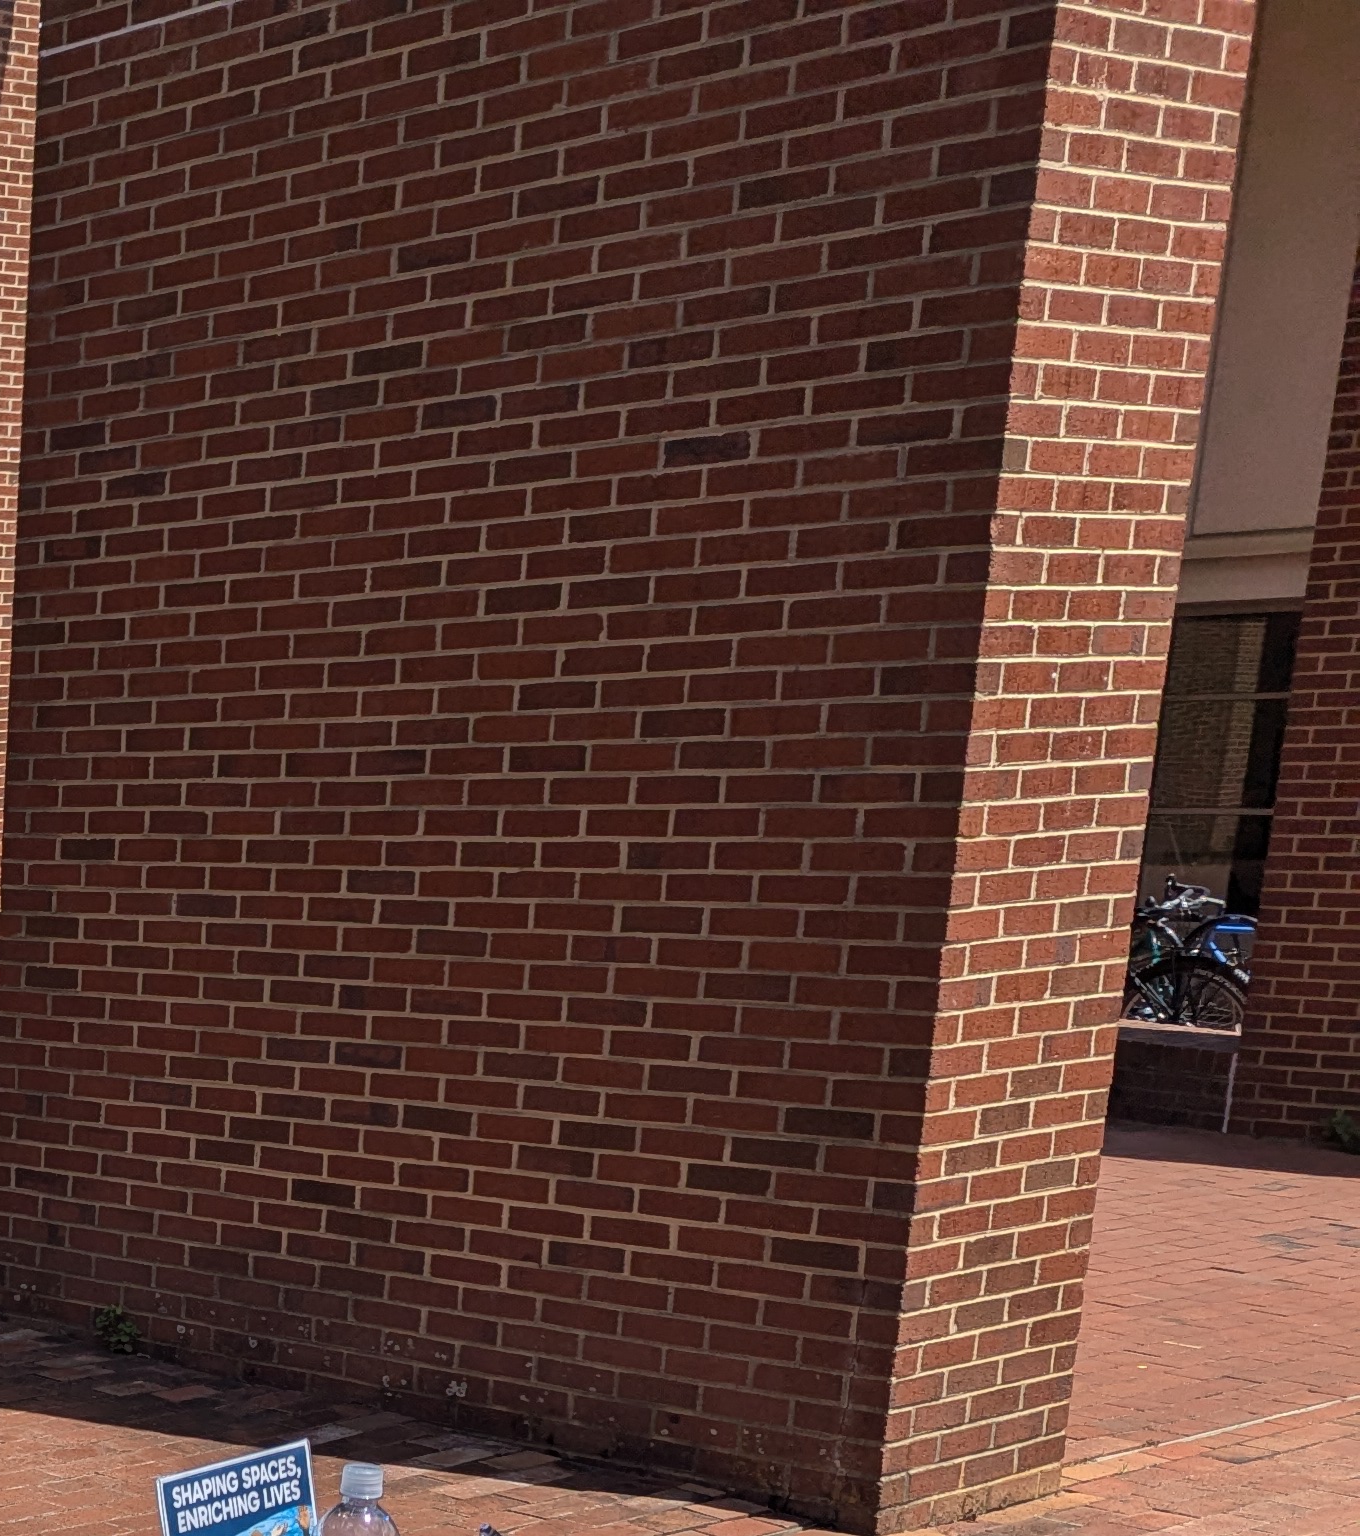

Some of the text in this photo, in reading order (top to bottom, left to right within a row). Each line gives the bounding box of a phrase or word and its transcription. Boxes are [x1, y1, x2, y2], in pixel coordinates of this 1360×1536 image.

[171, 1455, 301, 1509] SHAPING SPACES,
[177, 1479, 301, 1534] ENRICHING LIVES
